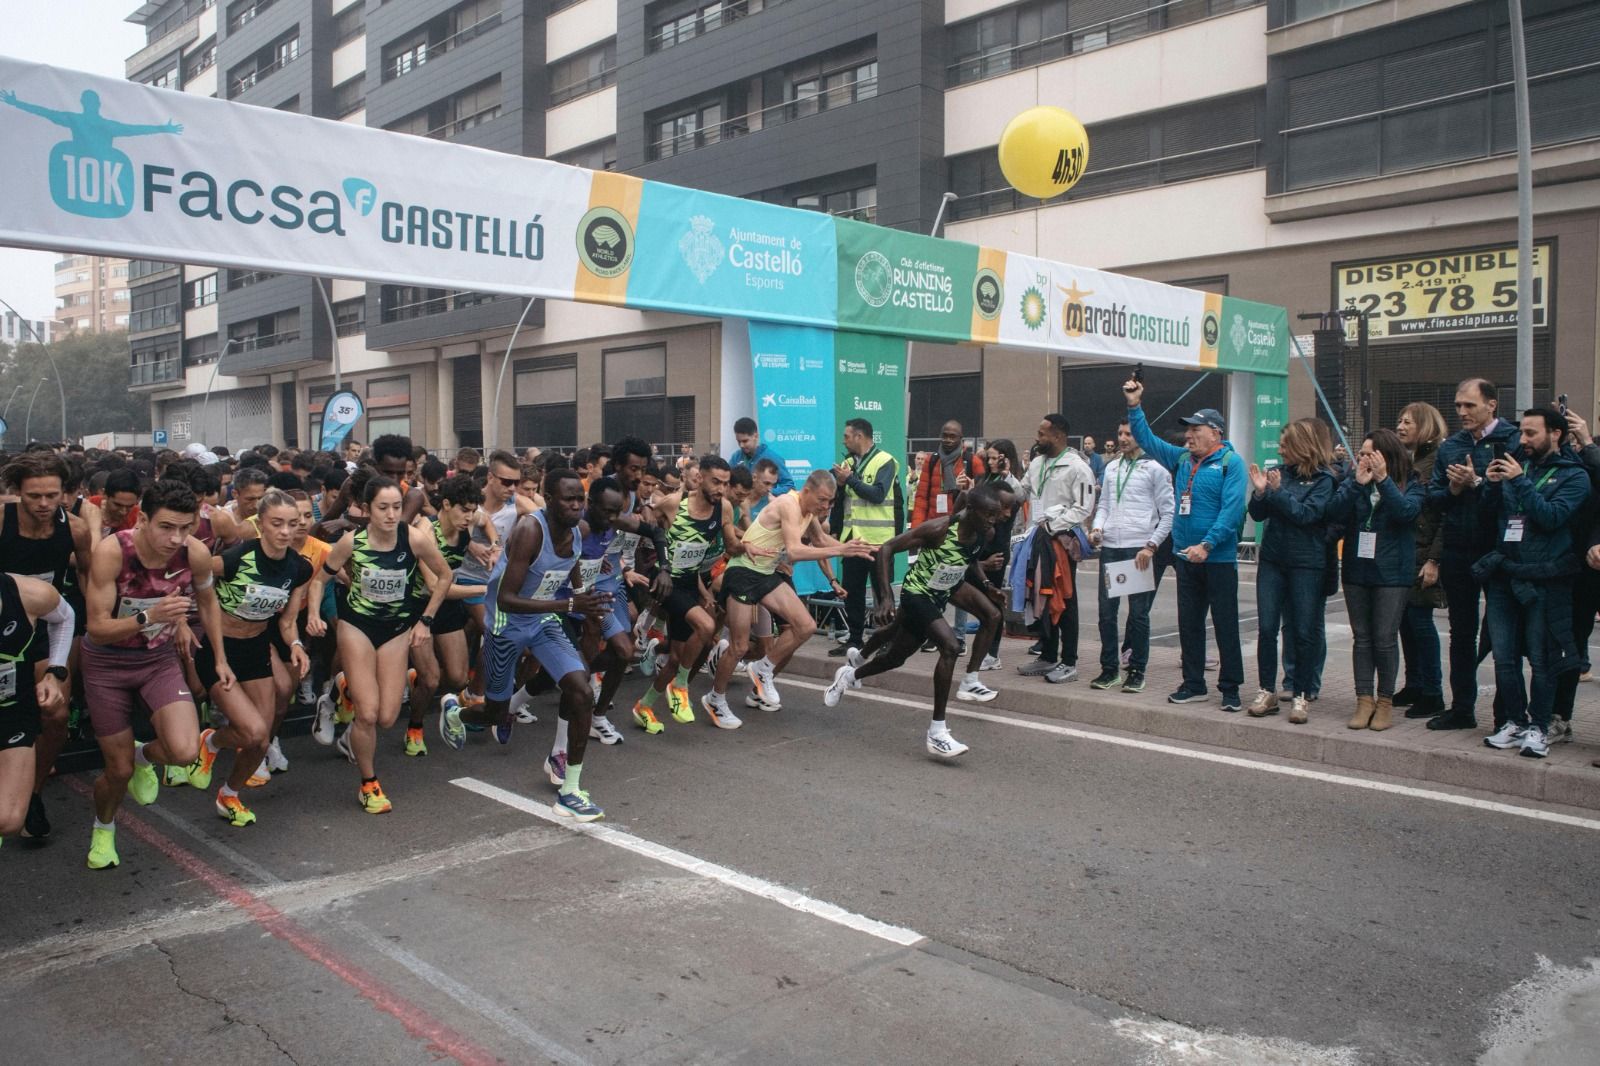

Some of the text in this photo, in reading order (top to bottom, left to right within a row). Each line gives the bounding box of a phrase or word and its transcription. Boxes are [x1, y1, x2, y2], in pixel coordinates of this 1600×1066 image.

[62, 154, 126, 206] 10K
[143, 163, 346, 237] Facsa
[382, 201, 545, 262] CASTELLÓ
[729, 227, 802, 250] Ajuntament de
[728, 243, 803, 276] Castelló
[900, 257, 913, 268] Club
[746, 273, 785, 290] Esports
[893, 267, 953, 293] RUNNING
[1036, 272, 1048, 287] bp
[1402, 277, 1442, 289] 2.419
[892, 289, 954, 313] CASTELLÓ
[1358, 291, 1407, 319] 23
[1423, 284, 1474, 314] 78
[1066, 302, 1127, 338] marató
[1129, 312, 1190, 347] CASTELLÓ
[854, 400, 882, 411] SALERA
[156, 431, 165, 442] P
[370, 579, 401, 590] 2054
[251, 597, 283, 610] 2048
